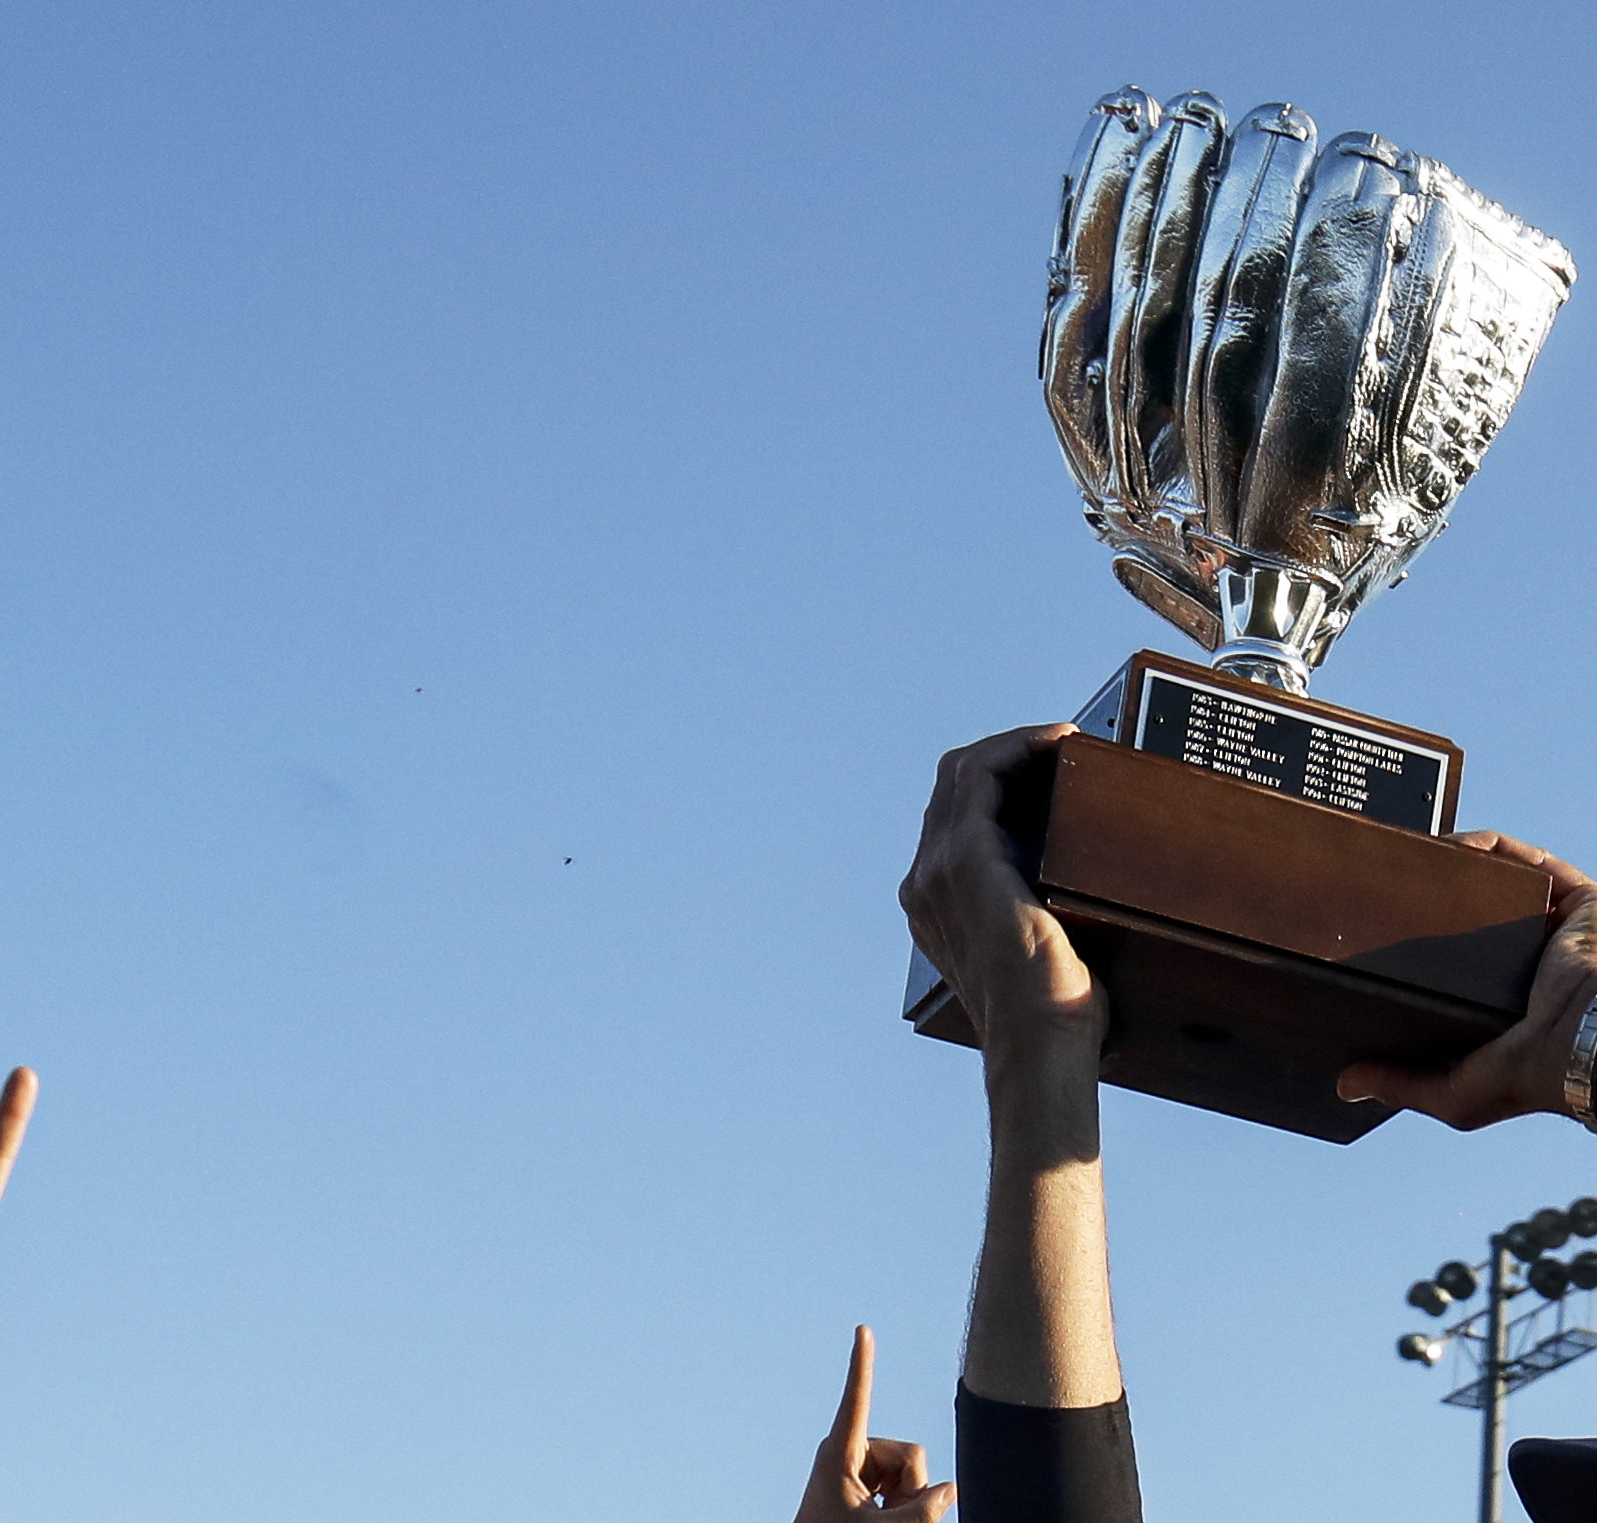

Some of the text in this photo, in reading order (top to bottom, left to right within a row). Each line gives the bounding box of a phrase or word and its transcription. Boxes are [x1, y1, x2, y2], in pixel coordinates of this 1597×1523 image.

[1218, 713, 1257, 731] CLIFTON
[1216, 725, 1255, 742] CLIFTON
[1213, 748, 1251, 766] CLIFTON
[1216, 737, 1248, 753] WAYNE
[1250, 746, 1285, 765] VALLEY
[1212, 760, 1243, 777] WAYNE
[1246, 770, 1282, 788] VALLEY
[1331, 758, 1366, 775] CLIFTON
[1332, 770, 1367, 787] CLIFTON
[1328, 794, 1363, 811] CLIFTON
